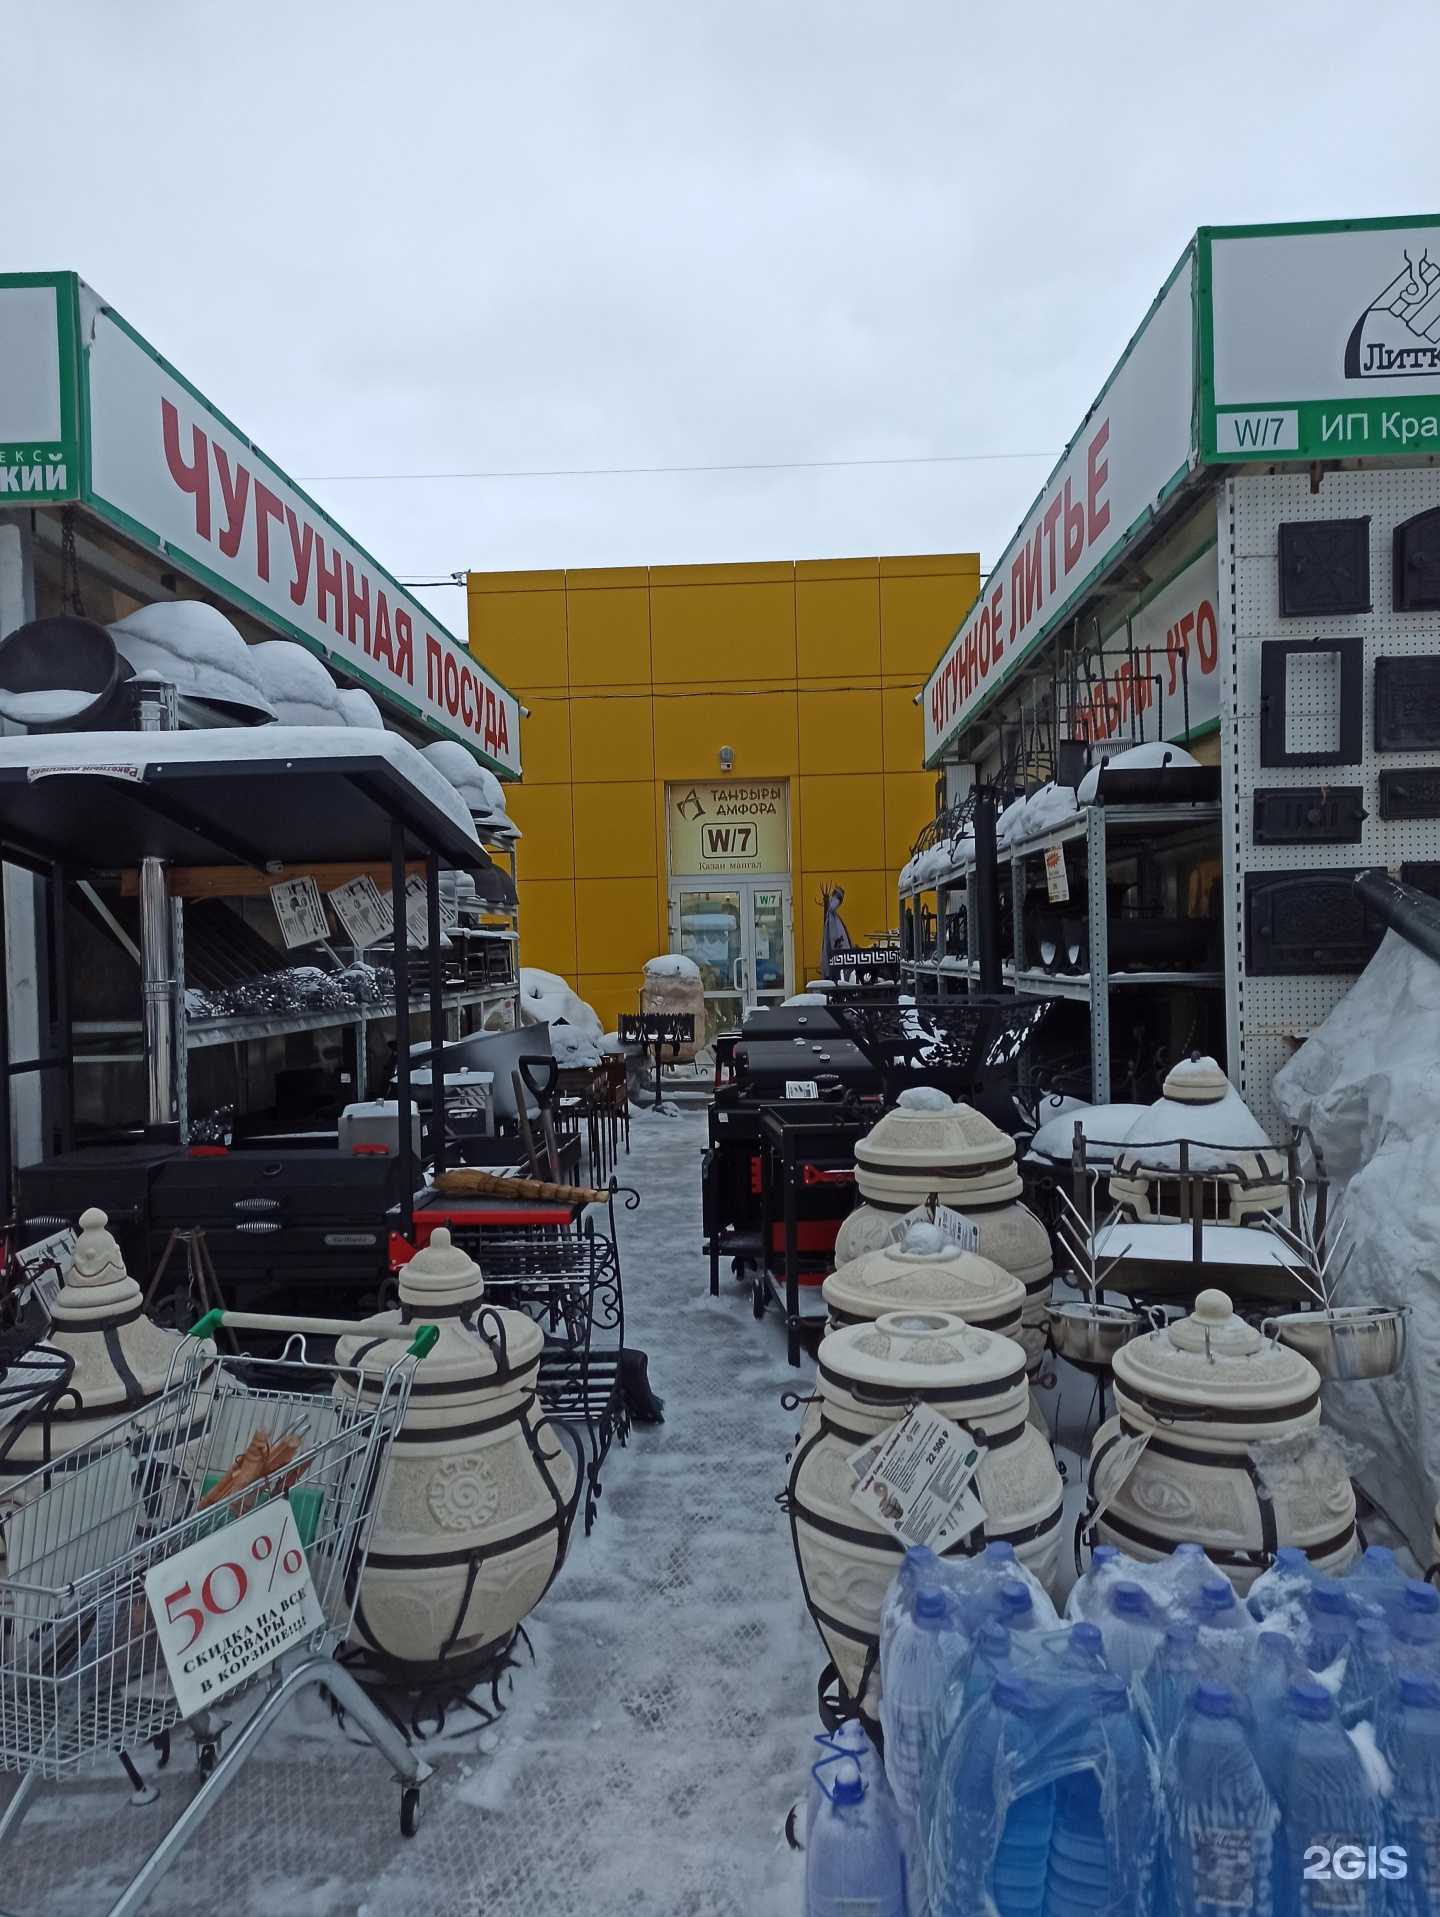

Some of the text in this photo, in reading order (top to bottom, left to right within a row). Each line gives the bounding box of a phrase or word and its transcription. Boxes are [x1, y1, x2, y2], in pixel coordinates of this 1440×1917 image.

[1234, 418, 1284, 447] W/7
[1322, 411, 1438, 445] ИП Кра
[161, 396, 510, 758] ЧУГУННАЯ ПОСУДА
[932, 417, 1111, 735] ЧУГУННОЕ ЛИТЬЕ
[711, 787, 781, 801] ТАНДЫРЫ
[717, 802, 777, 816] АМФОРА
[707, 828, 752, 853] W/7
[183, 1587, 307, 1675] СКИДКА НА ВСЕ
[220, 1615, 286, 1666] ТОВАРЫ
[200, 1679, 213, 1695] В
